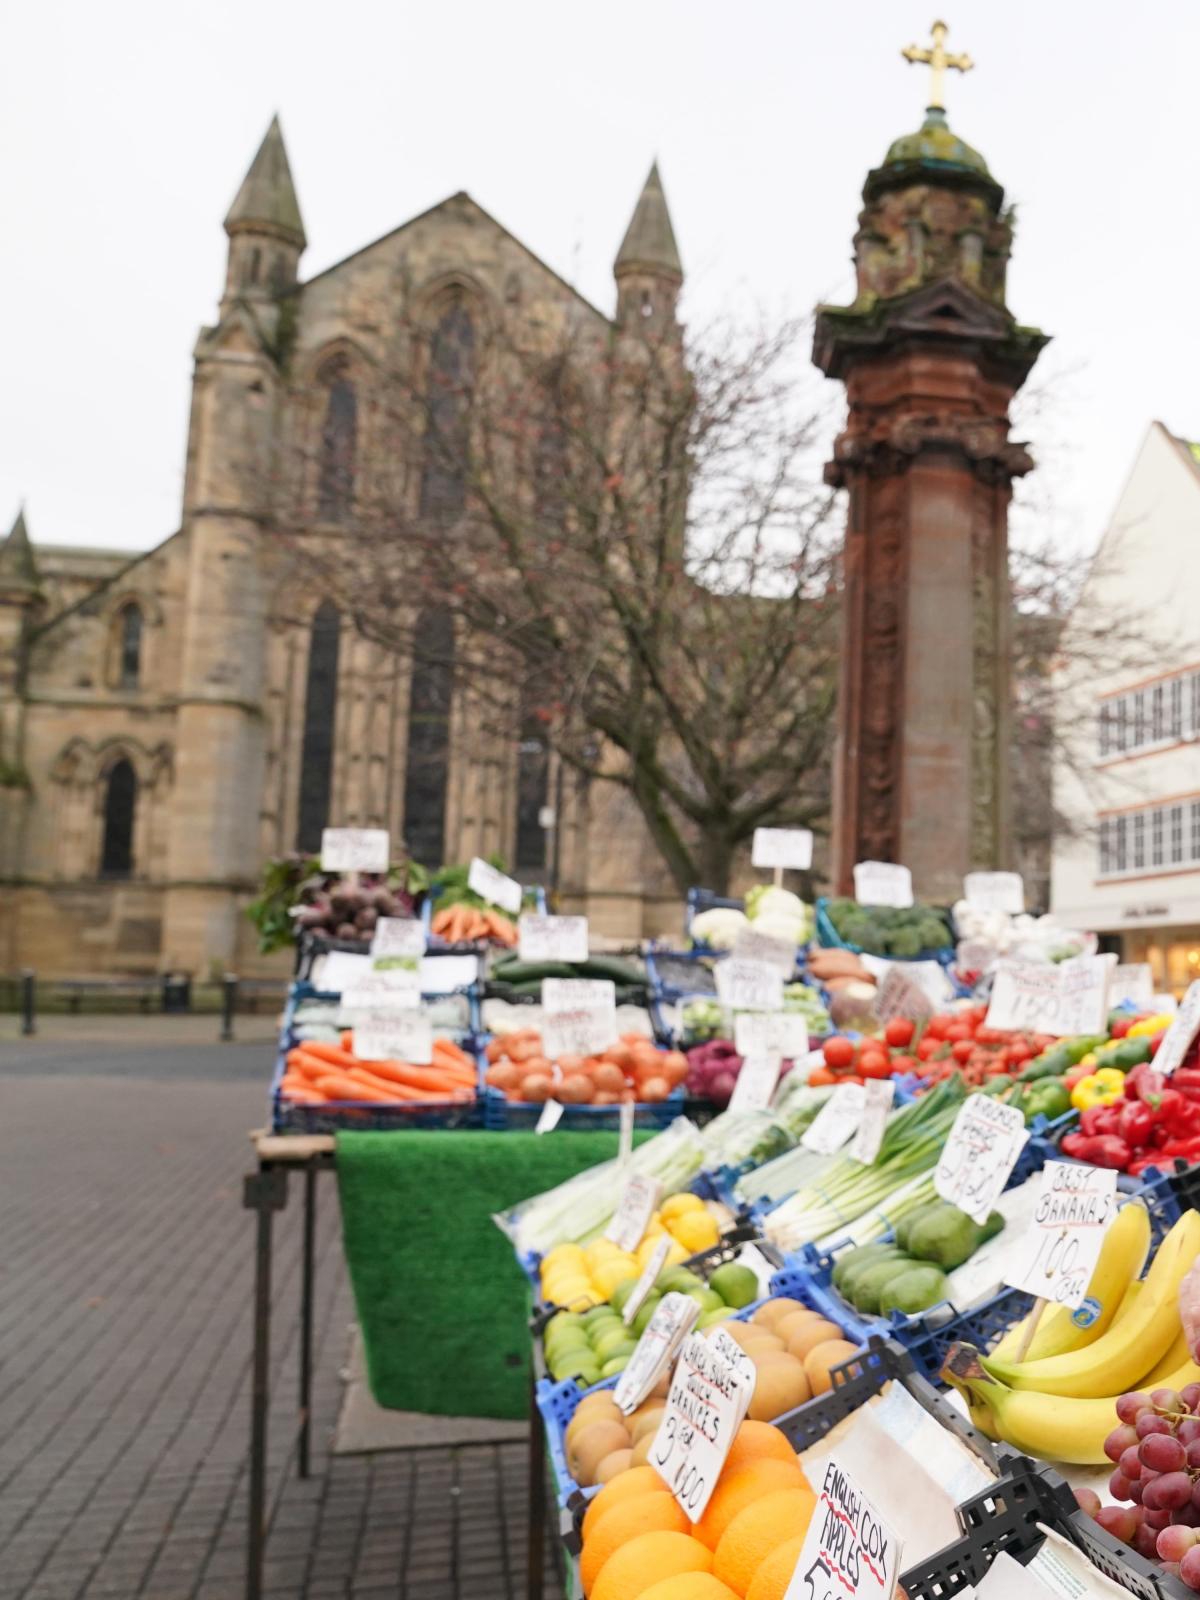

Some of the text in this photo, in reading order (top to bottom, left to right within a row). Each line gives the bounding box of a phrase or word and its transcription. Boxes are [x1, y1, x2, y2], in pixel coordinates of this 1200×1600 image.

[1052, 1165, 1097, 1193] BEST
[1035, 1192, 1112, 1225] BANANAS
[819, 1507, 863, 1588] APPLES
[823, 1461, 888, 1581] ENGLISH COX
